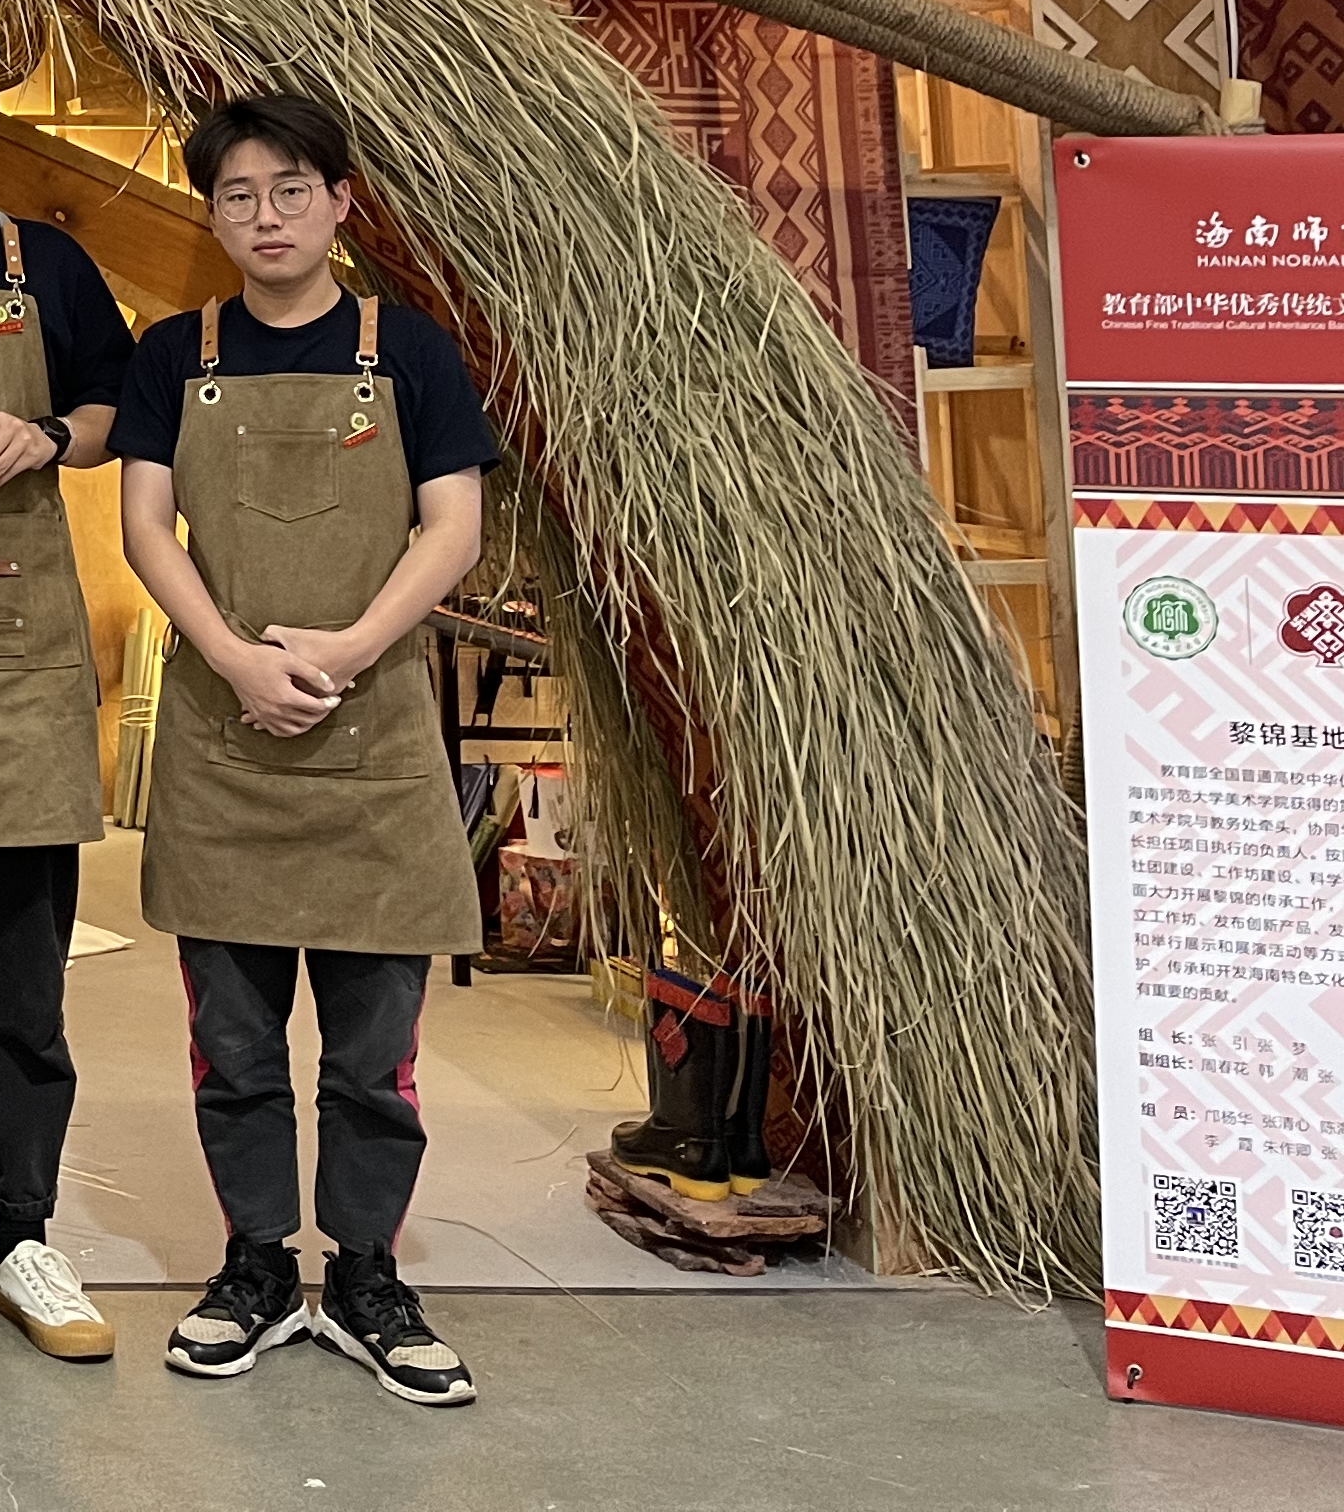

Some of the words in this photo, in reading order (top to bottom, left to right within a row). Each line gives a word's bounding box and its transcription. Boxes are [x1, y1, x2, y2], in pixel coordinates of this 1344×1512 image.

[1197, 254, 1266, 268] HAINAN
[1102, 319, 1144, 330] Chinese
[1146, 319, 1169, 330] Fine
[1171, 319, 1224, 330] Traditional
[1226, 319, 1266, 330] Cultural
[1229, 721, 1344, 750] 黎锦基地
[1128, 810, 1344, 837] 美术学院与教务处牵头，协同
[1131, 835, 1344, 862] 长担任项目执行的负责人。按
